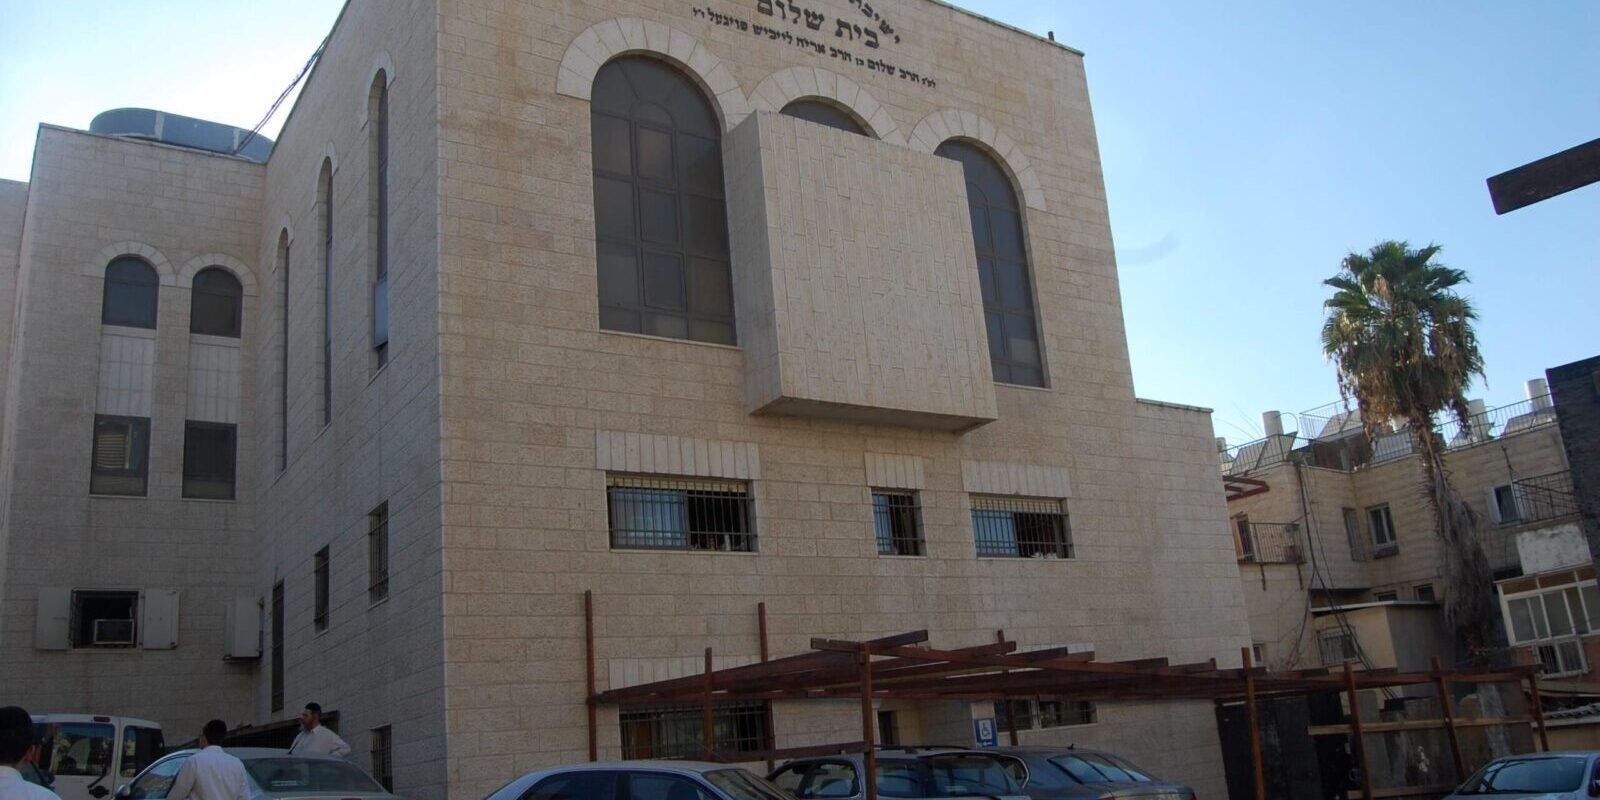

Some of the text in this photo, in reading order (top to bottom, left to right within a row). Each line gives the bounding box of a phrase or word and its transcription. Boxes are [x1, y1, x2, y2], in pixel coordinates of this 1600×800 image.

[757, 0, 880, 49] בית שלום
[752, 24, 793, 45] לייביש
[796, 37, 826, 55] אריה
[829, 46, 852, 62] הרב
[855, 57, 864, 66] בן
[867, 59, 895, 75] שלום
[898, 68, 920, 83] הרב
